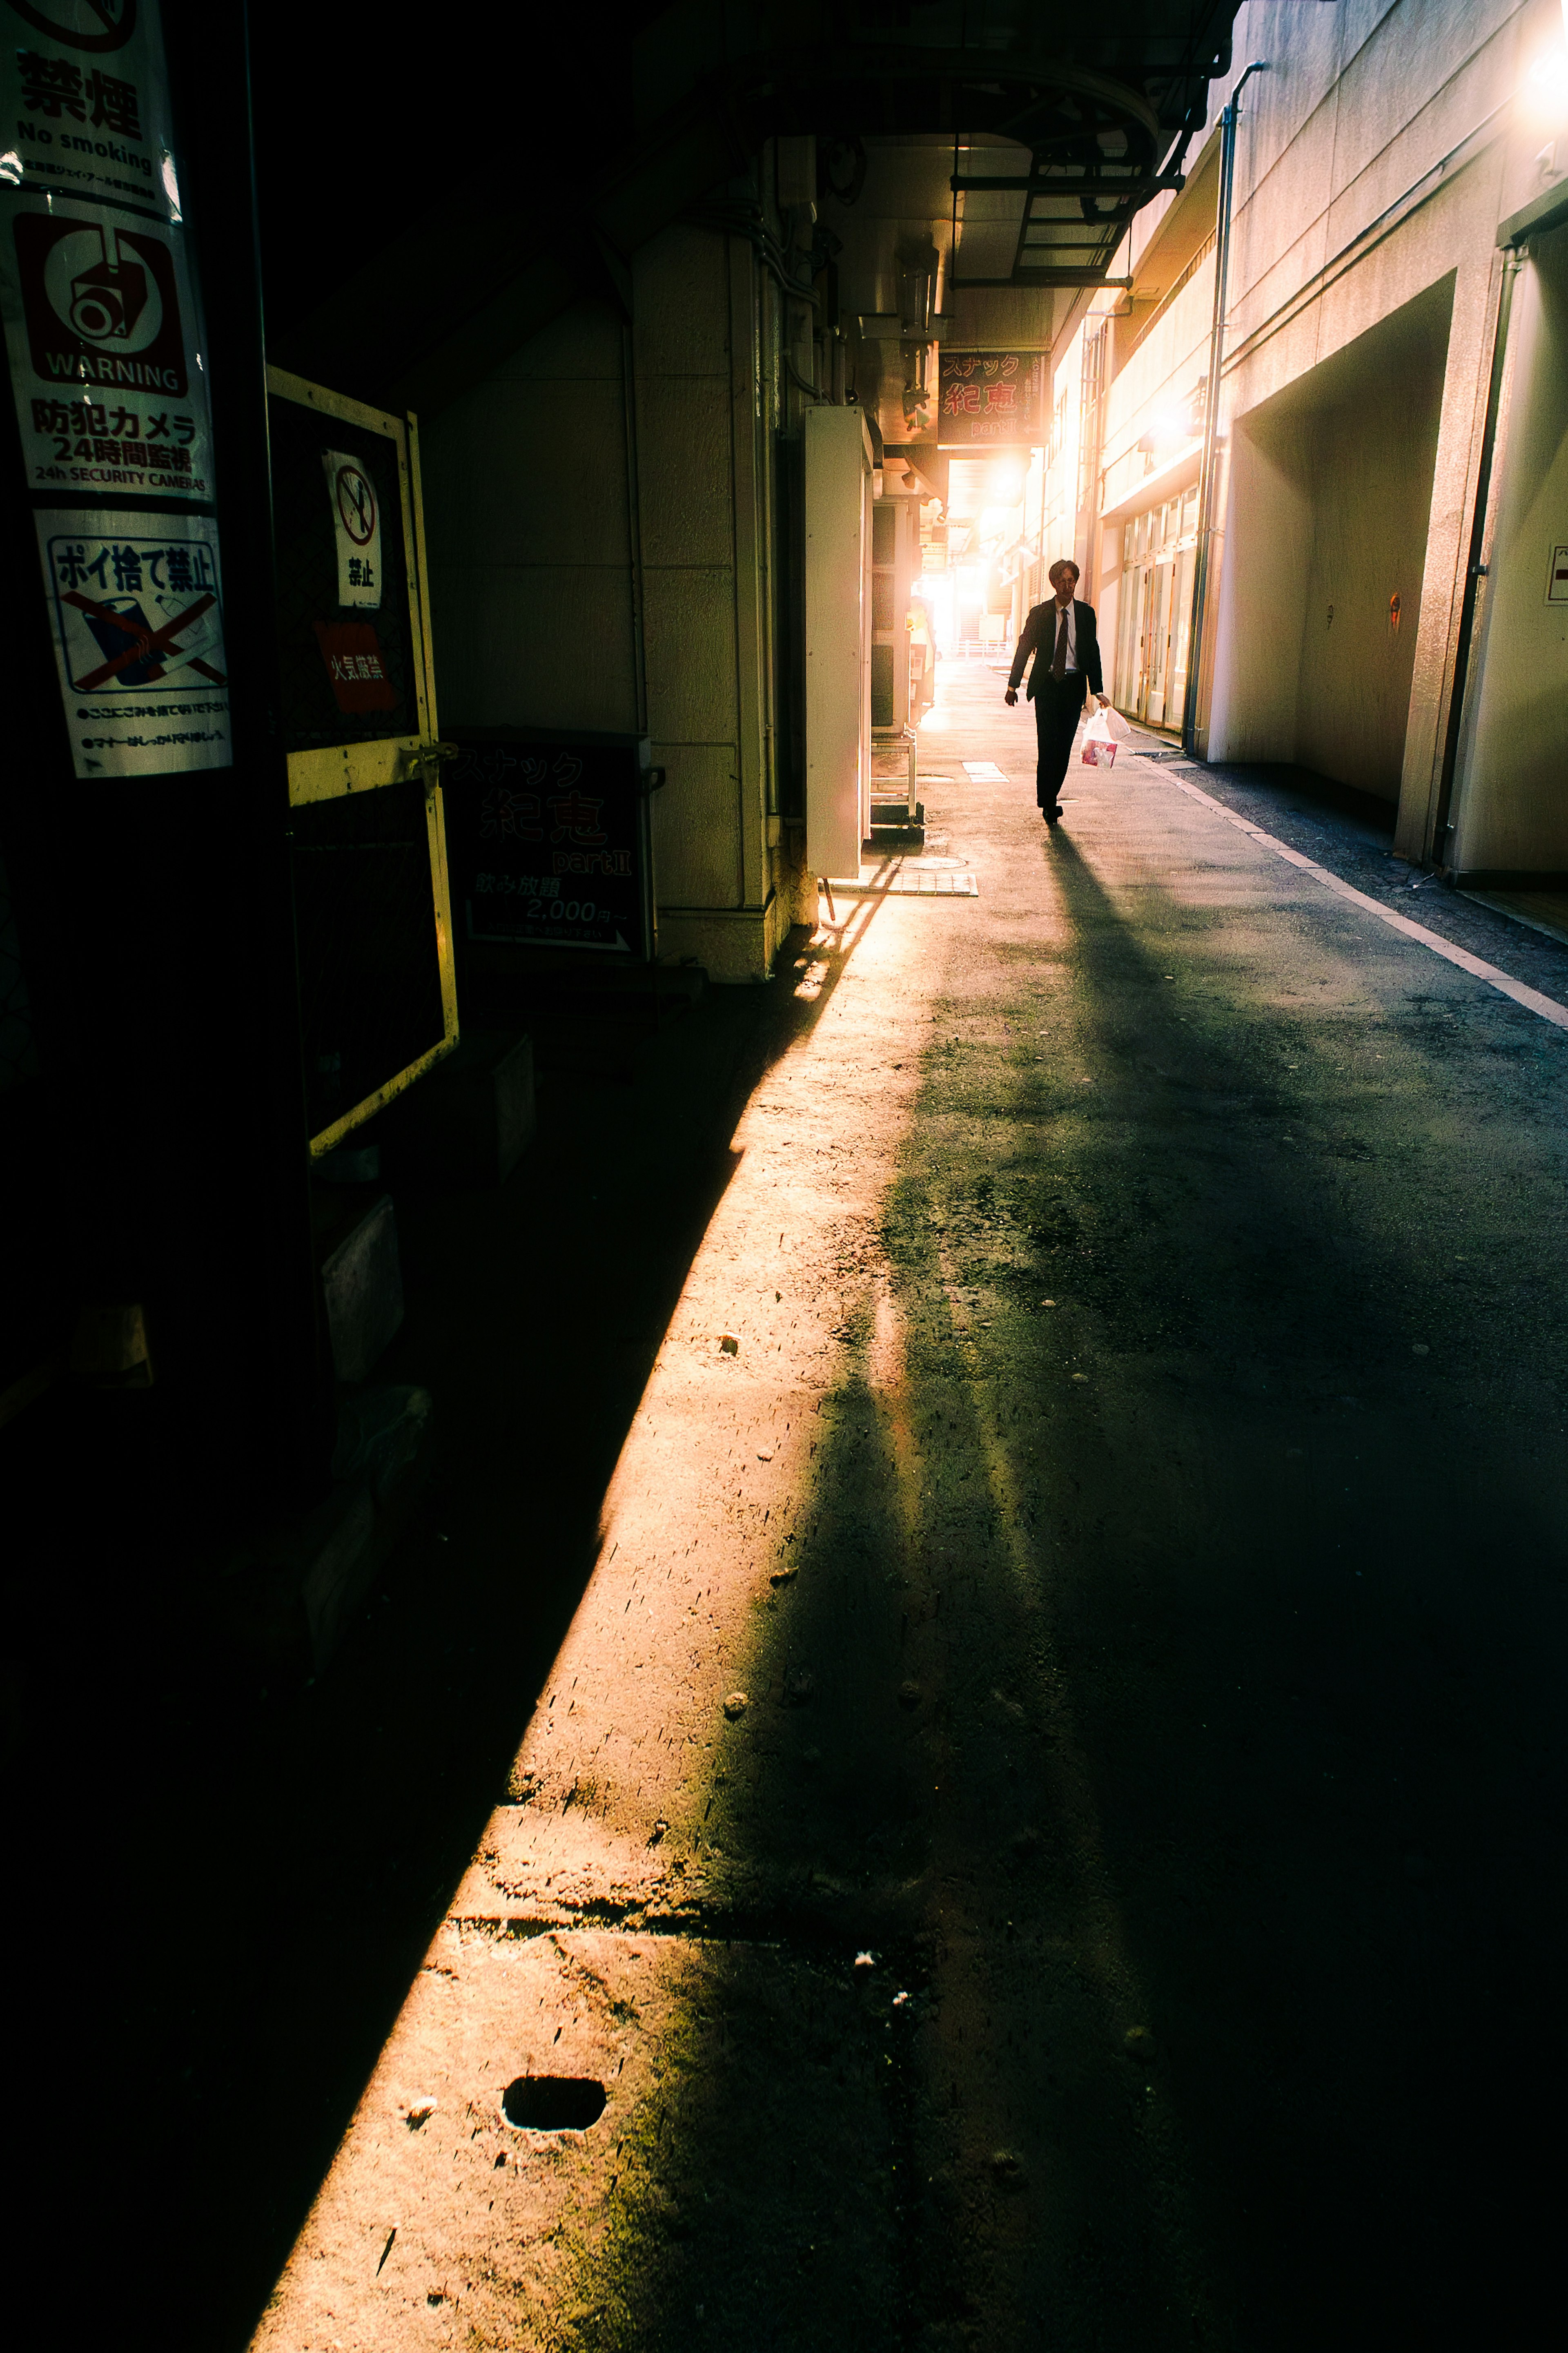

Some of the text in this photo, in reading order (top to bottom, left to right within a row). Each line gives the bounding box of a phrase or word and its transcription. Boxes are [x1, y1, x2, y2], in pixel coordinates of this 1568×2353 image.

[16, 51, 143, 141] 禁煙
[18, 120, 151, 177] No smoking
[45, 352, 180, 391] WARNING
[942, 355, 1019, 377] スナック
[942, 381, 1018, 416] 紀恵
[31, 399, 195, 445] 防犯カメラ
[53, 437, 193, 473] 24時間監視
[35, 466, 205, 491] 24h SECURITY CAMERAS
[58, 544, 214, 592] ポイ捨て禁止
[349, 557, 374, 587] 禁止
[331, 654, 384, 681] 火気厳禁
[452, 748, 583, 787] スナック
[479, 787, 608, 845] 紀恵
[474, 872, 563, 898] 飲み放題
